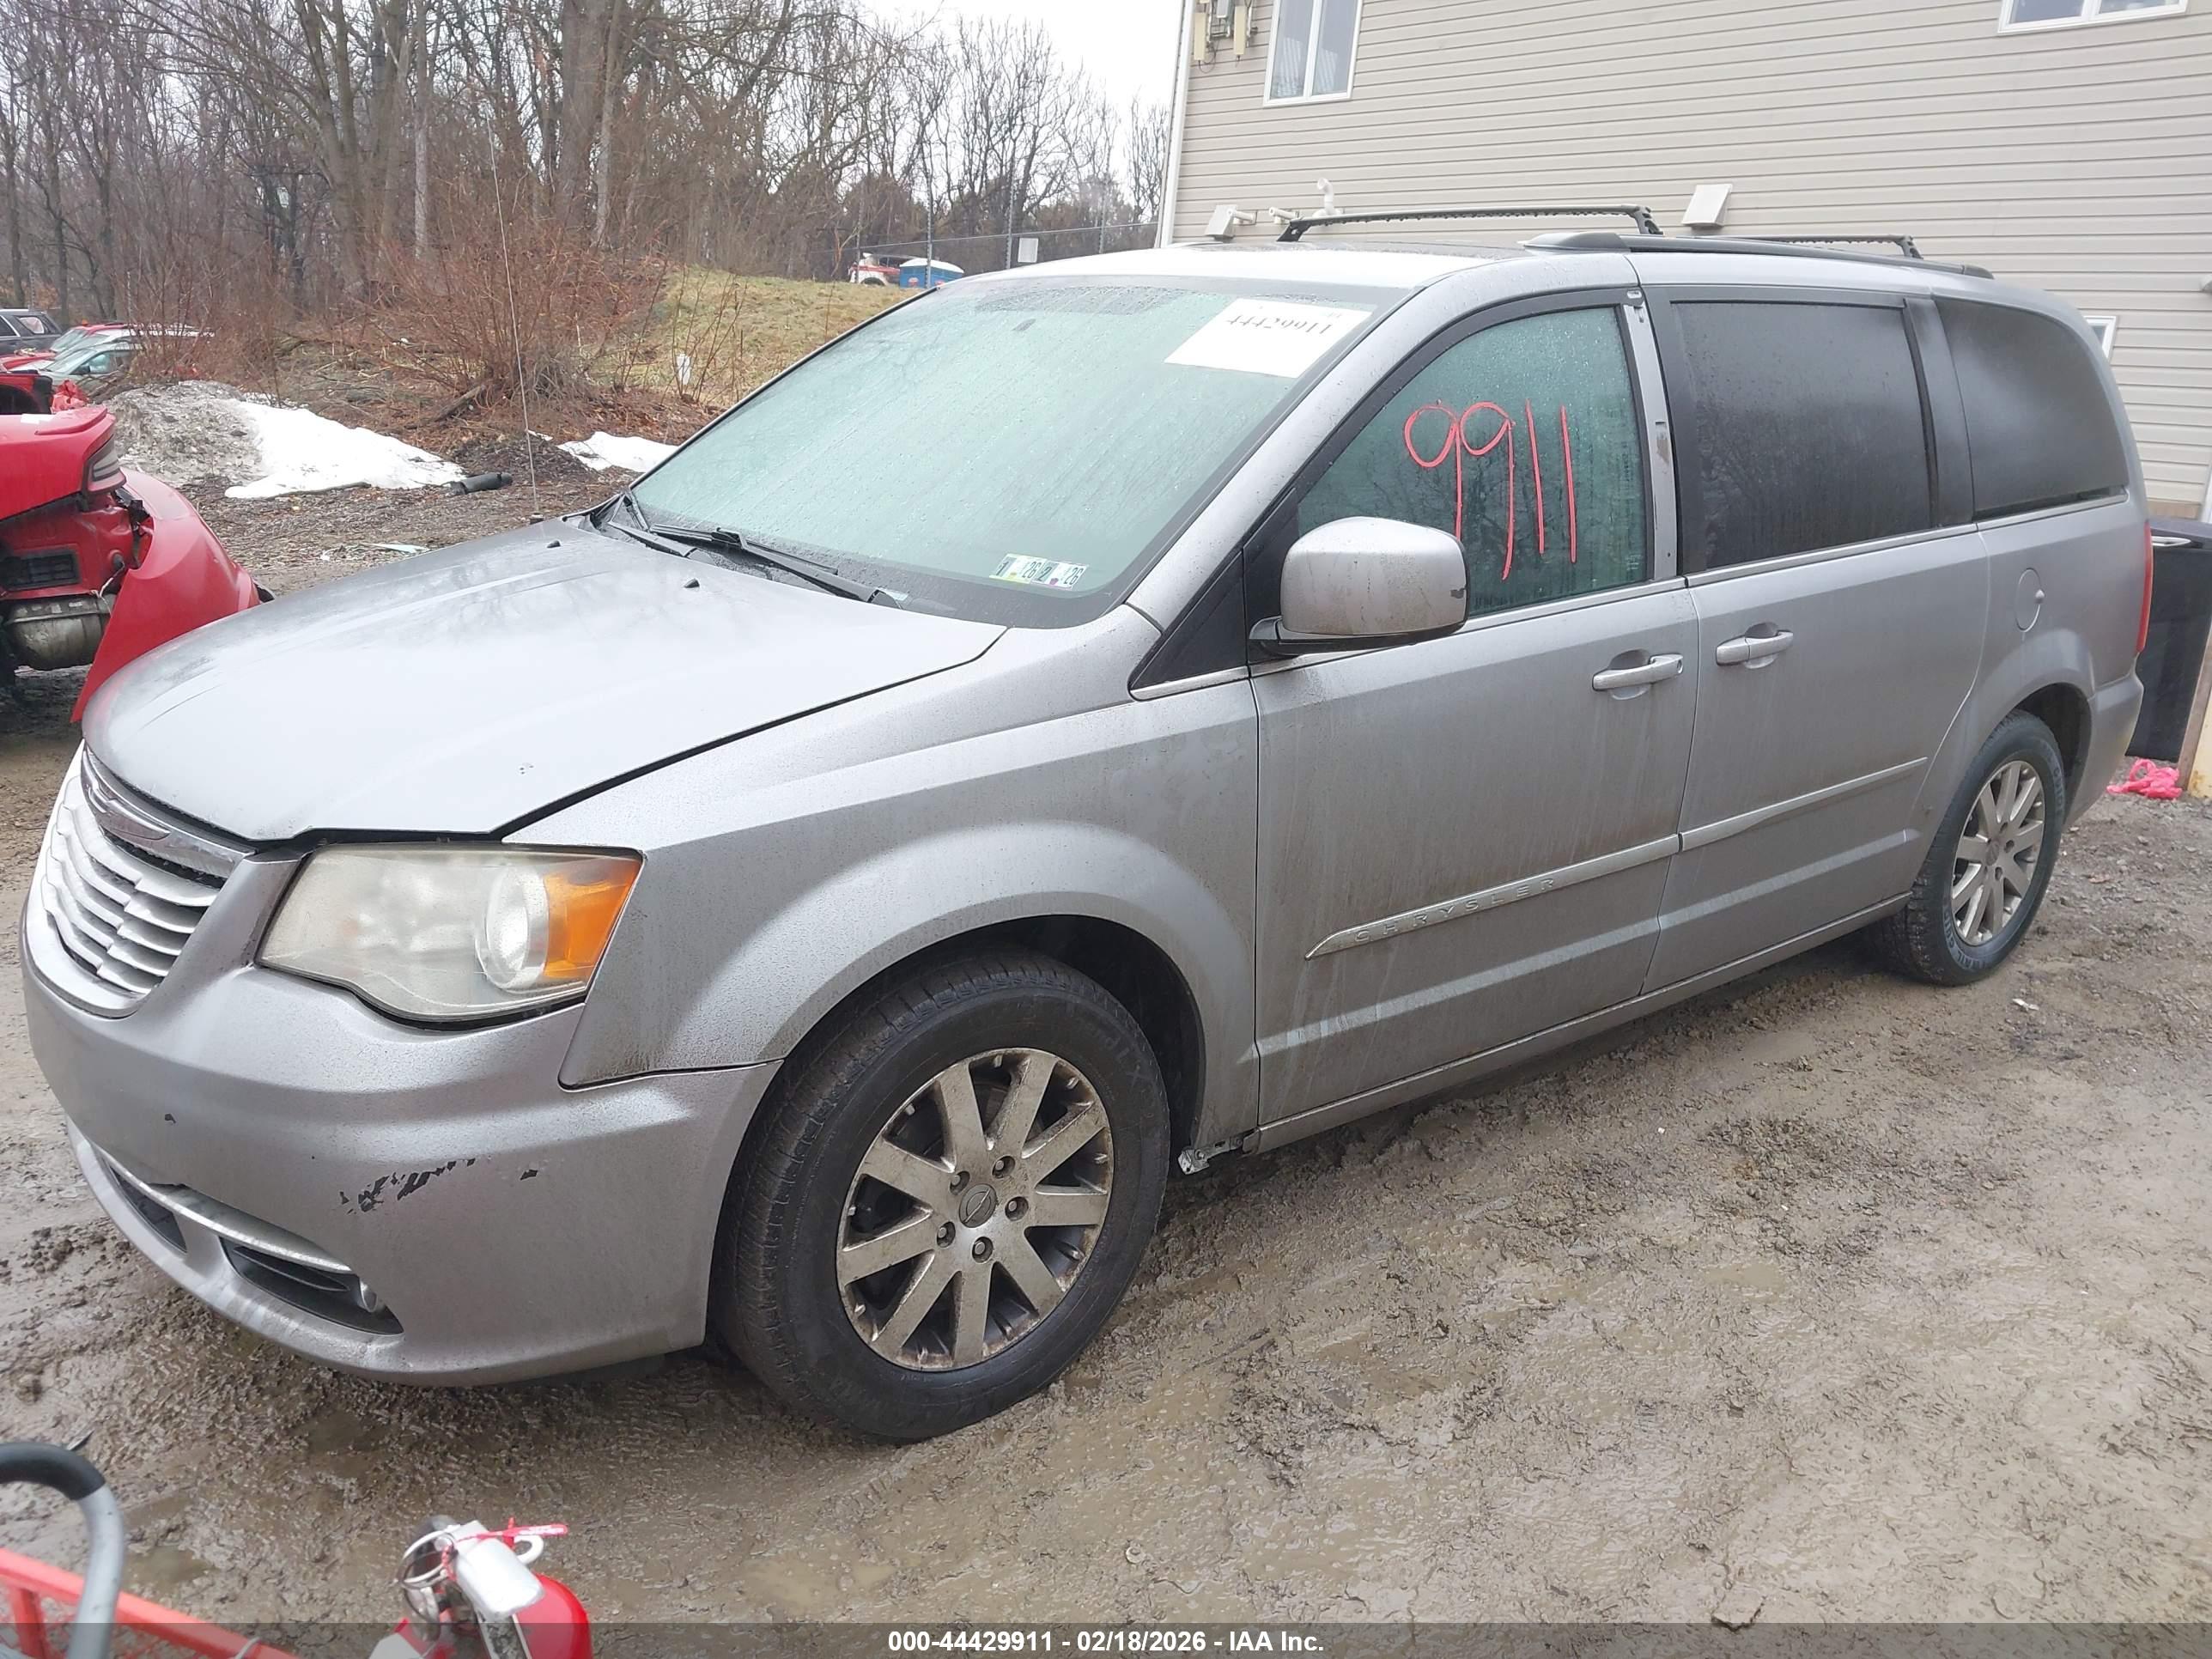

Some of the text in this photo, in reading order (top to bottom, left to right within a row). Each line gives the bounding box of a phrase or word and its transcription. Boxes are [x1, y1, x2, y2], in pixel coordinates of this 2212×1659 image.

[1404, 398, 1577, 580] 9911
[1022, 561, 1042, 579] 26
[1064, 567, 1084, 585] 26
[1354, 878, 1554, 943] CHRYSLER
